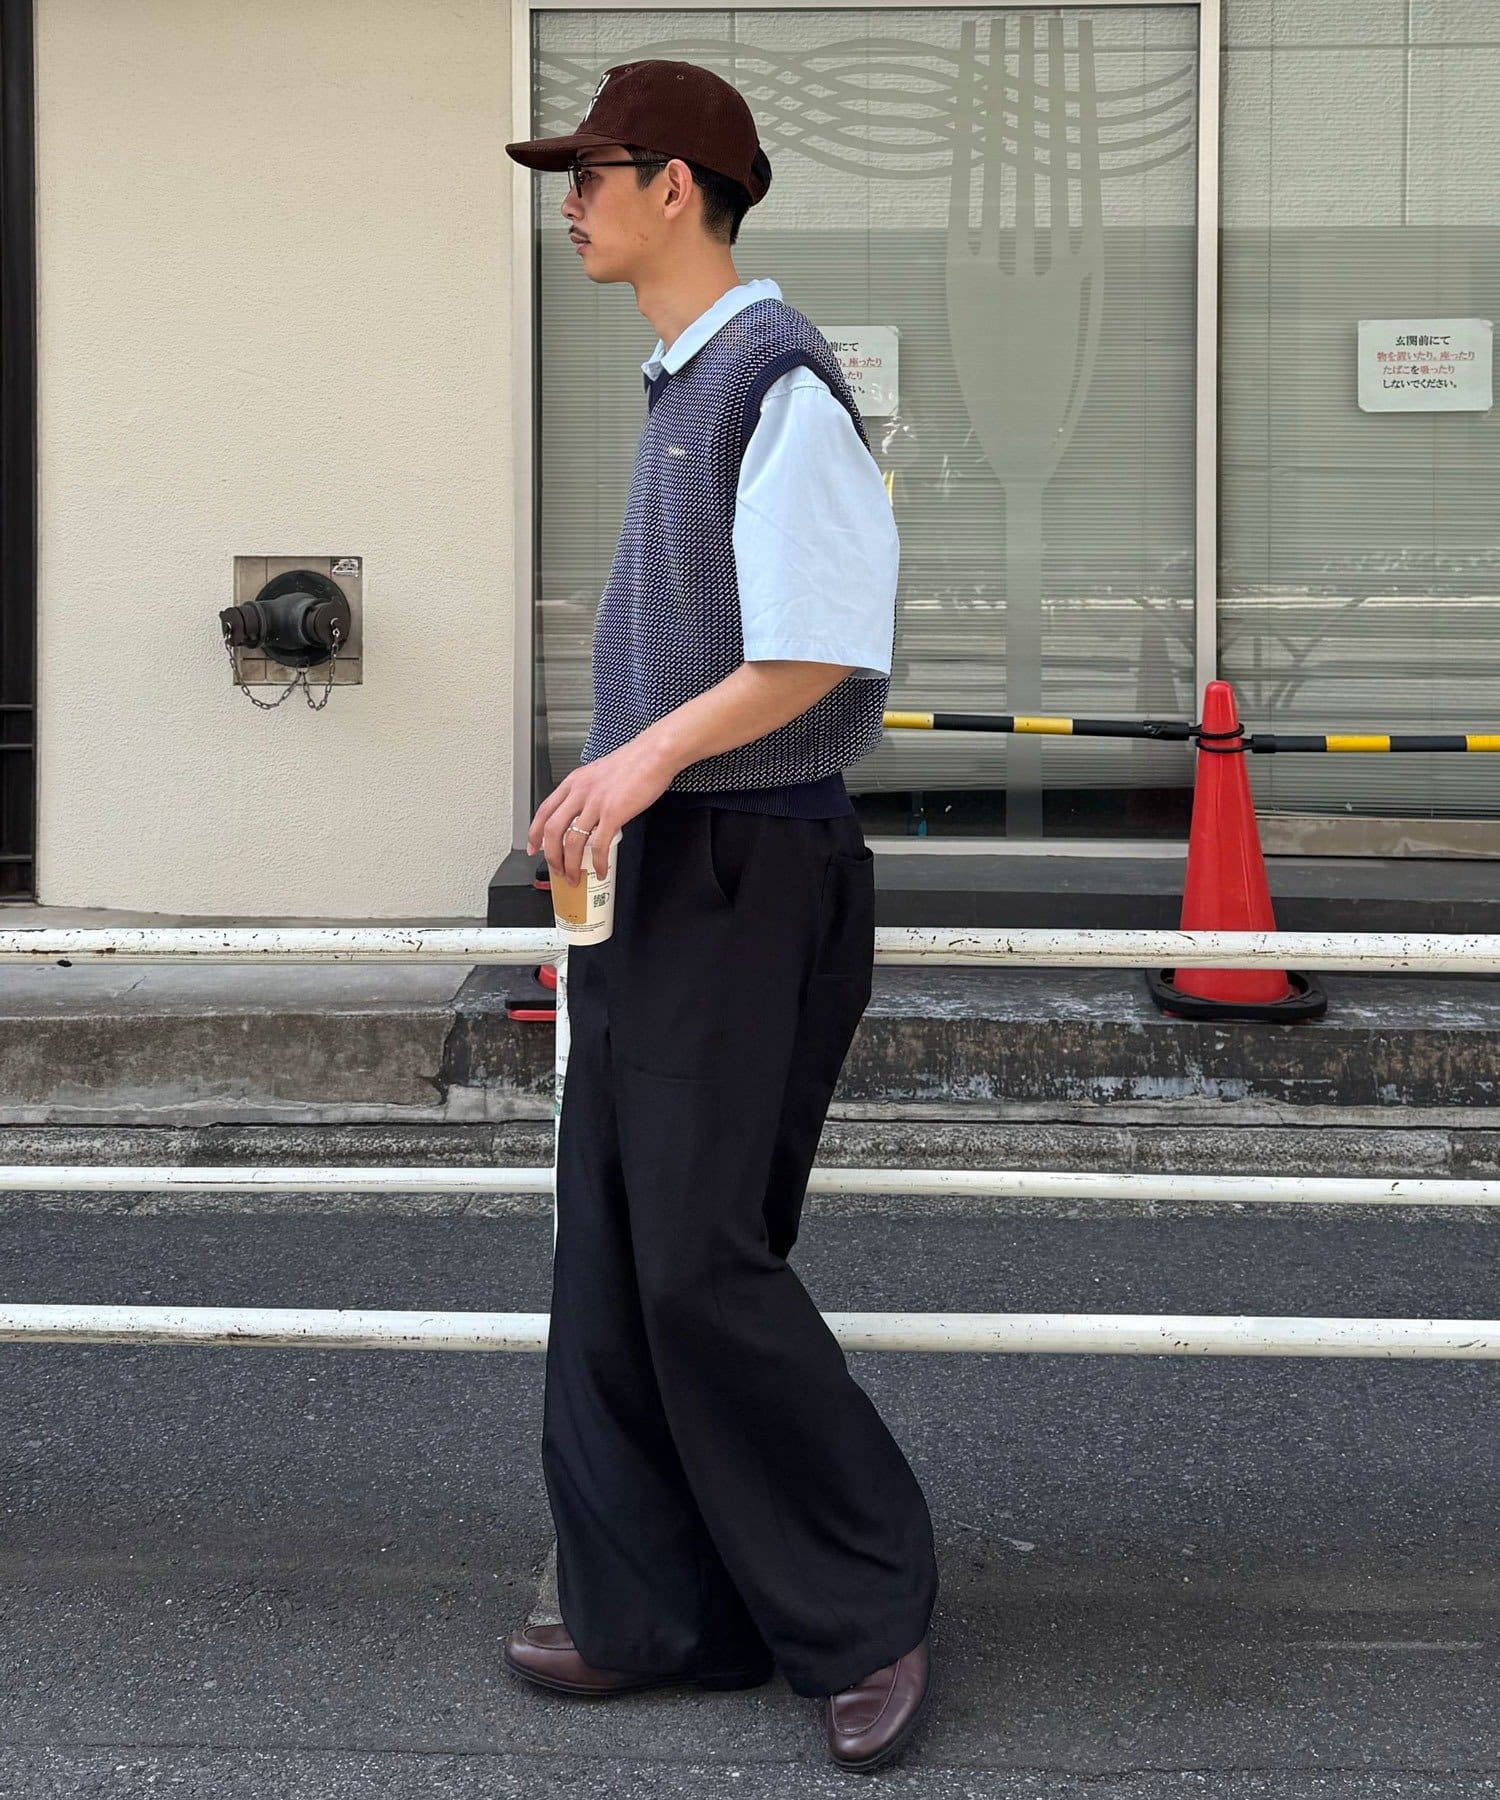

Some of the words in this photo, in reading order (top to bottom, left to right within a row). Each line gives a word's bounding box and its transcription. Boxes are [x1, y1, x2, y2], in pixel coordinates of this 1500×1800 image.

[1395, 335, 1451, 346] 玄関前にて
[1382, 365, 1455, 375] たばこを吸ったり
[1383, 379, 1457, 389] しないでください。
